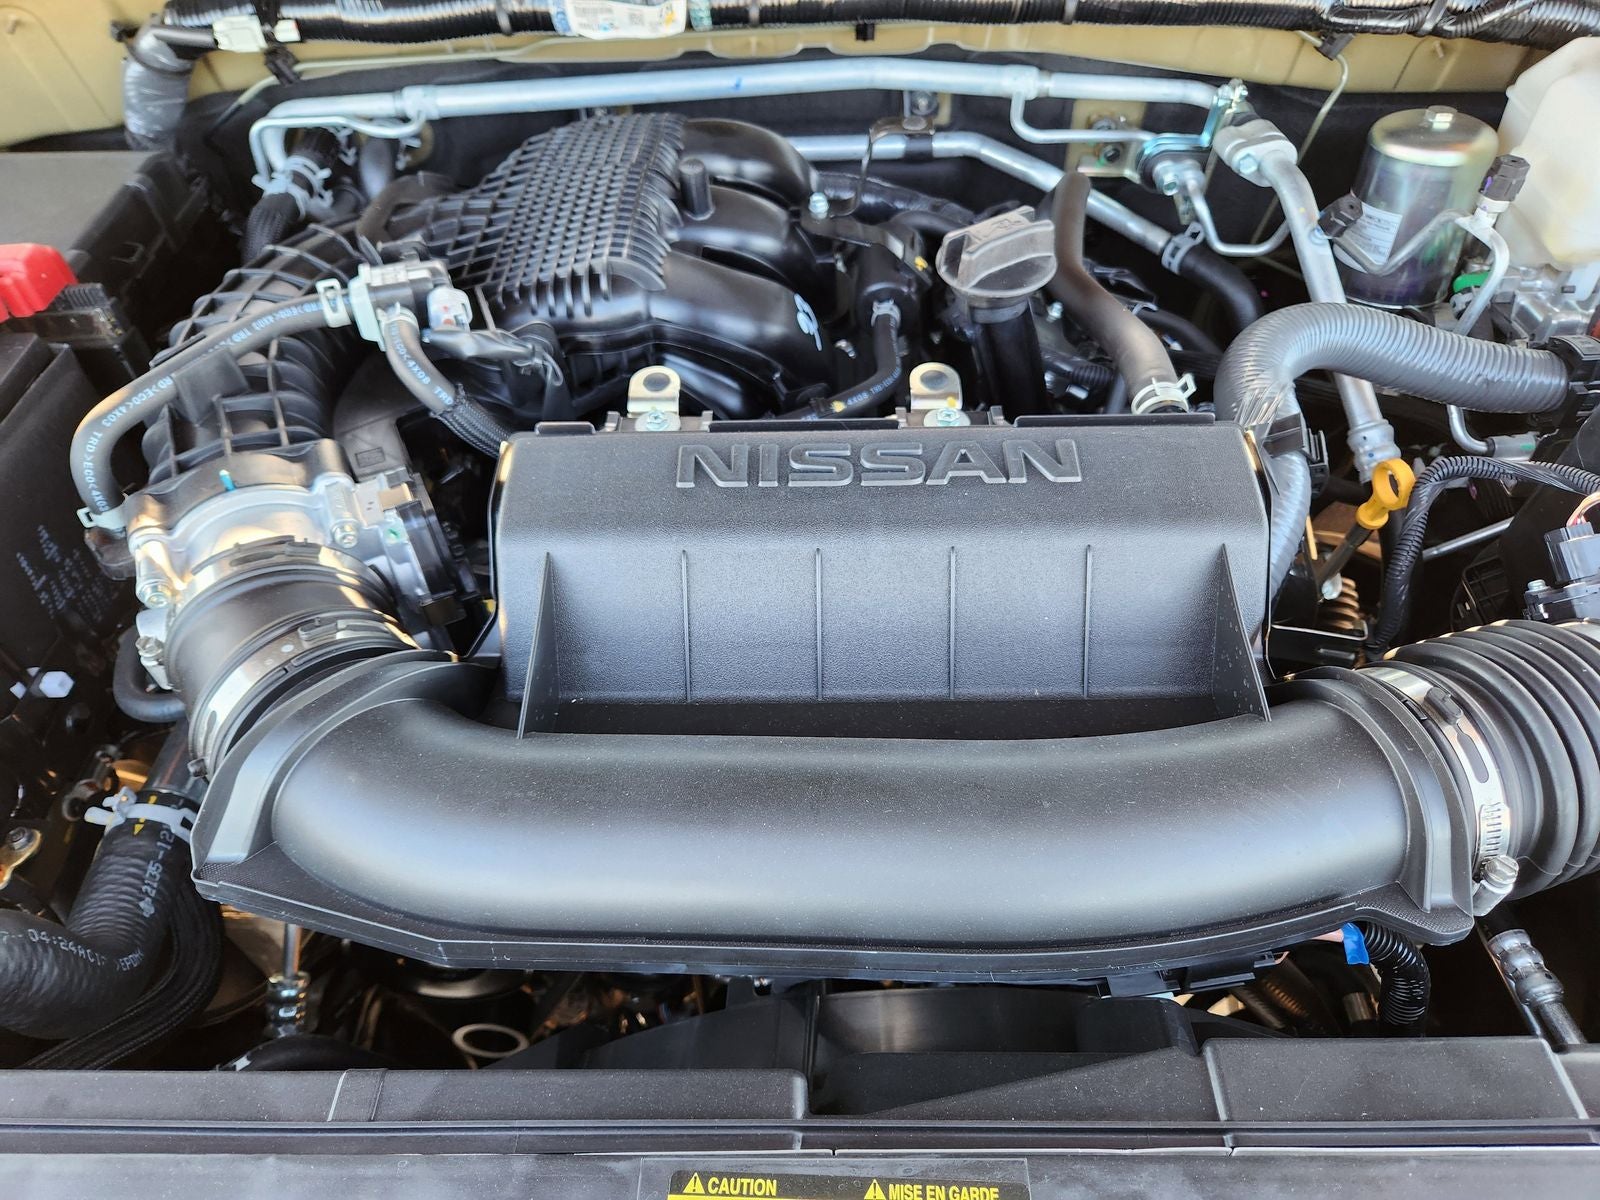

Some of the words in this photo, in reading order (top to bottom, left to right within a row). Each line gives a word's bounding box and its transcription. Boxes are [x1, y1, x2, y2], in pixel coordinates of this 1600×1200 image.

[676, 439, 1083, 488] NISSAN
[707, 1176, 777, 1196] CAUTION
[888, 1183, 922, 1200] MISE
[926, 1185, 945, 1200] EN
[948, 1186, 1000, 1200] GARDE
